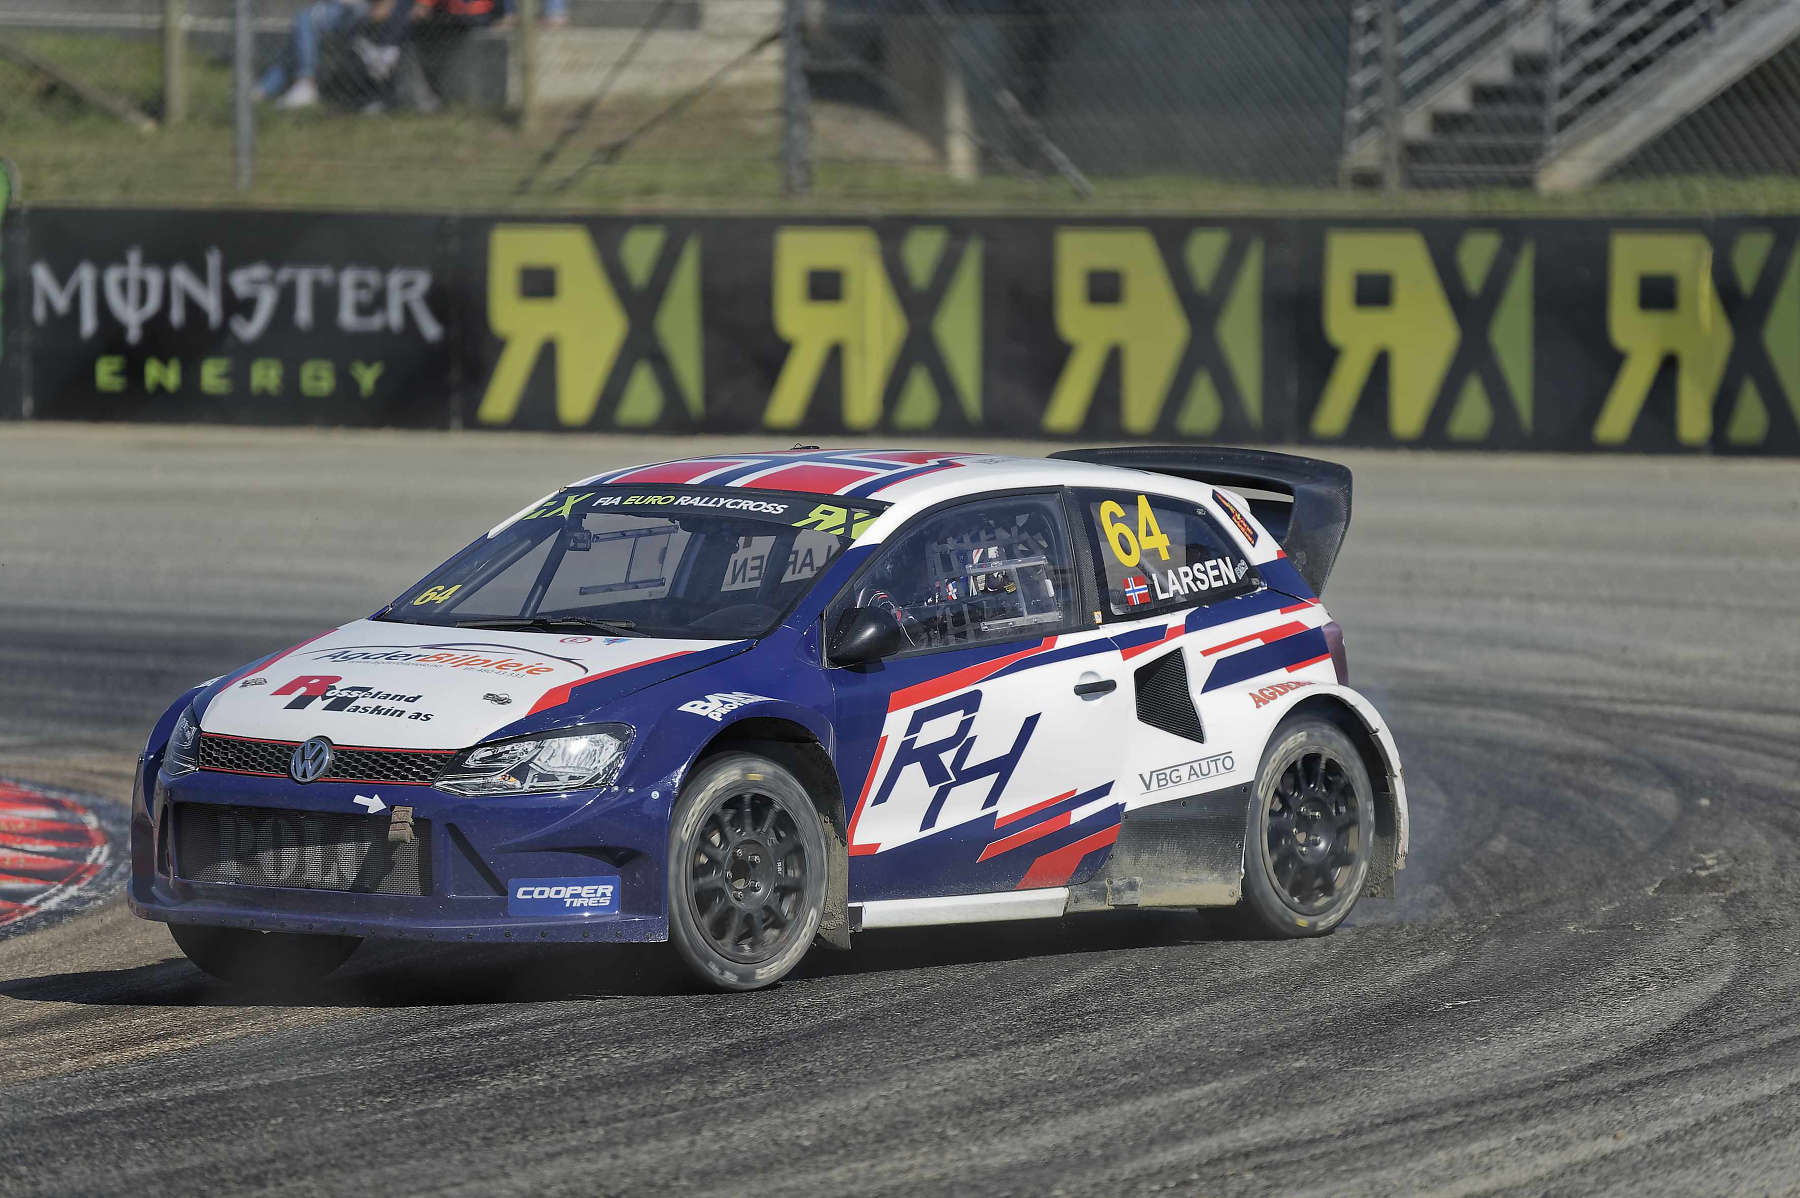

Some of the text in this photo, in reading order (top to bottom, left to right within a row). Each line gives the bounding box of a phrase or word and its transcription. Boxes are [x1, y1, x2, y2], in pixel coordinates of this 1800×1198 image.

[30, 242, 444, 346] MONSTER
[95, 355, 385, 397] ENERGY
[592, 494, 789, 515] FIA EURO RALLYCROSS
[1099, 493, 1171, 568] 64
[413, 584, 462, 606] 64
[1151, 556, 1237, 601] LARSEN
[407, 711, 434, 721] as
[871, 689, 1042, 832] RH
[1138, 755, 1235, 791] VBG AUTO
[516, 885, 614, 899] COOPER
[563, 897, 611, 908] TIRES
